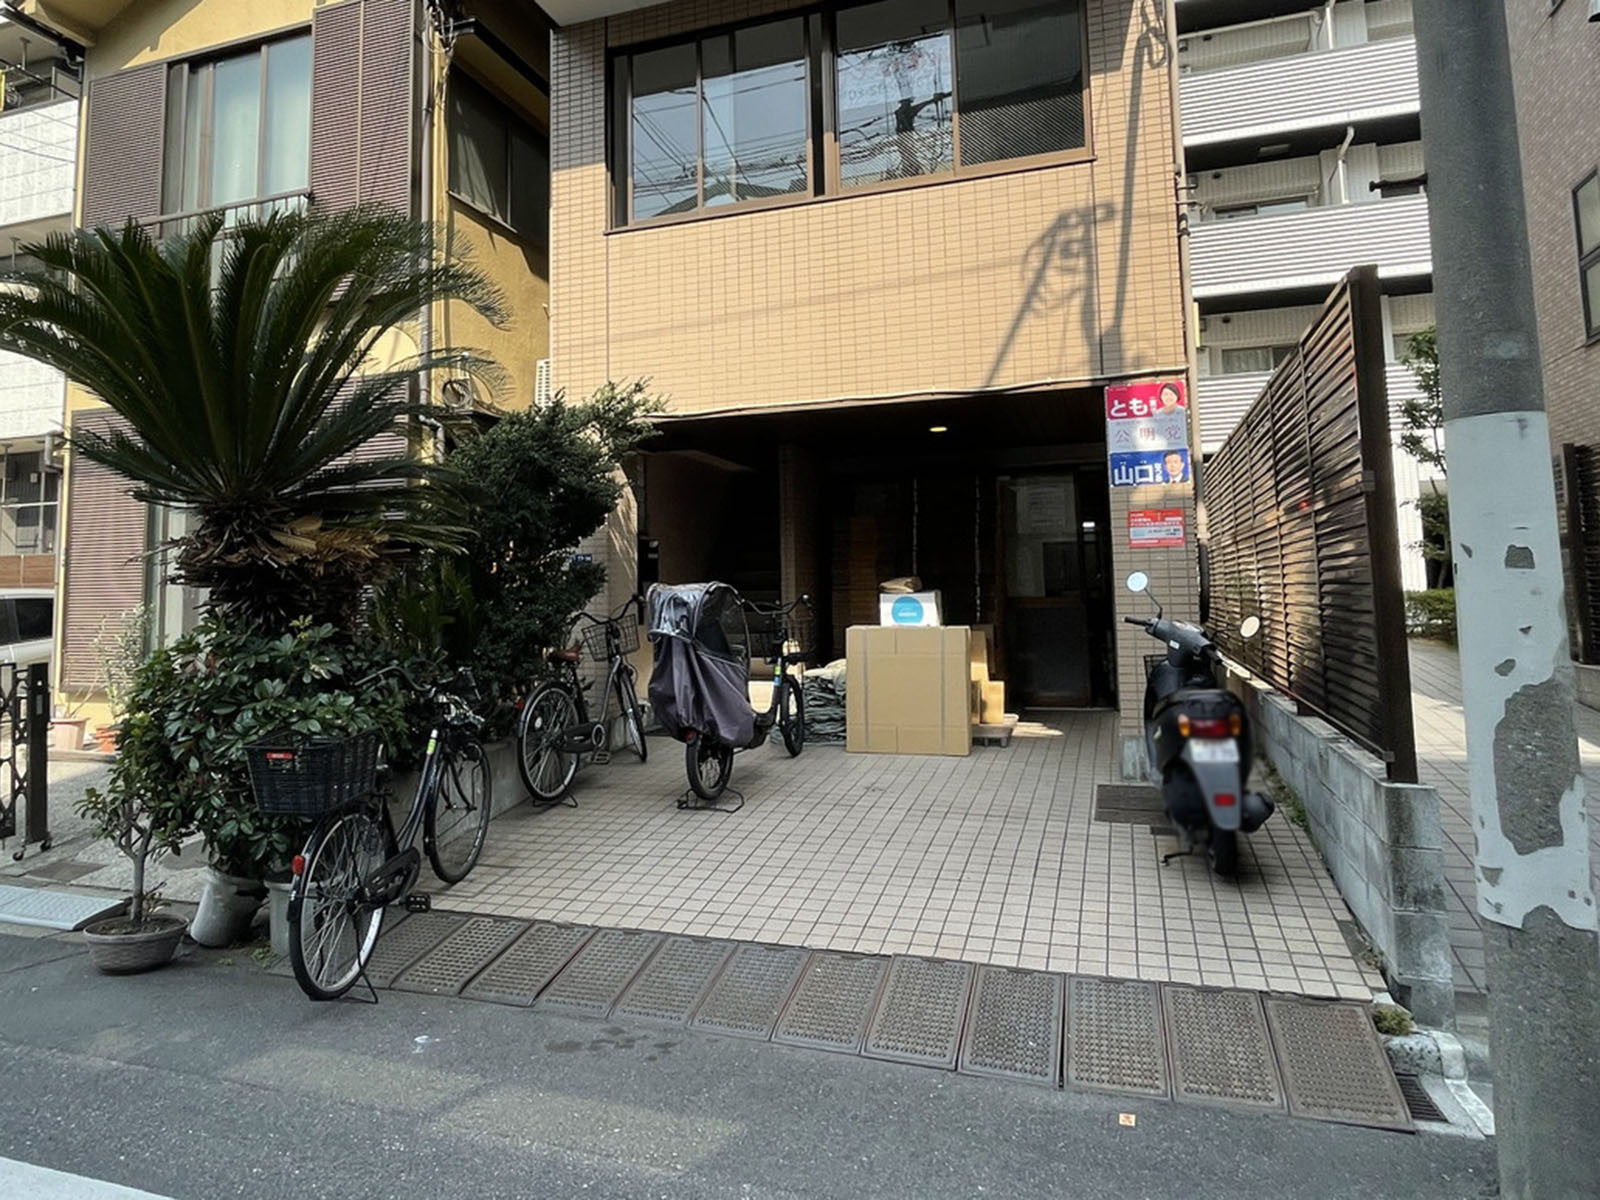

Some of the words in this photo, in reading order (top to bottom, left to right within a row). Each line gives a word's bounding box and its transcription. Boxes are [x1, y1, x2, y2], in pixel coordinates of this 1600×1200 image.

[1115, 424, 1182, 444] 公明党
[1114, 465, 1154, 485] 山口
